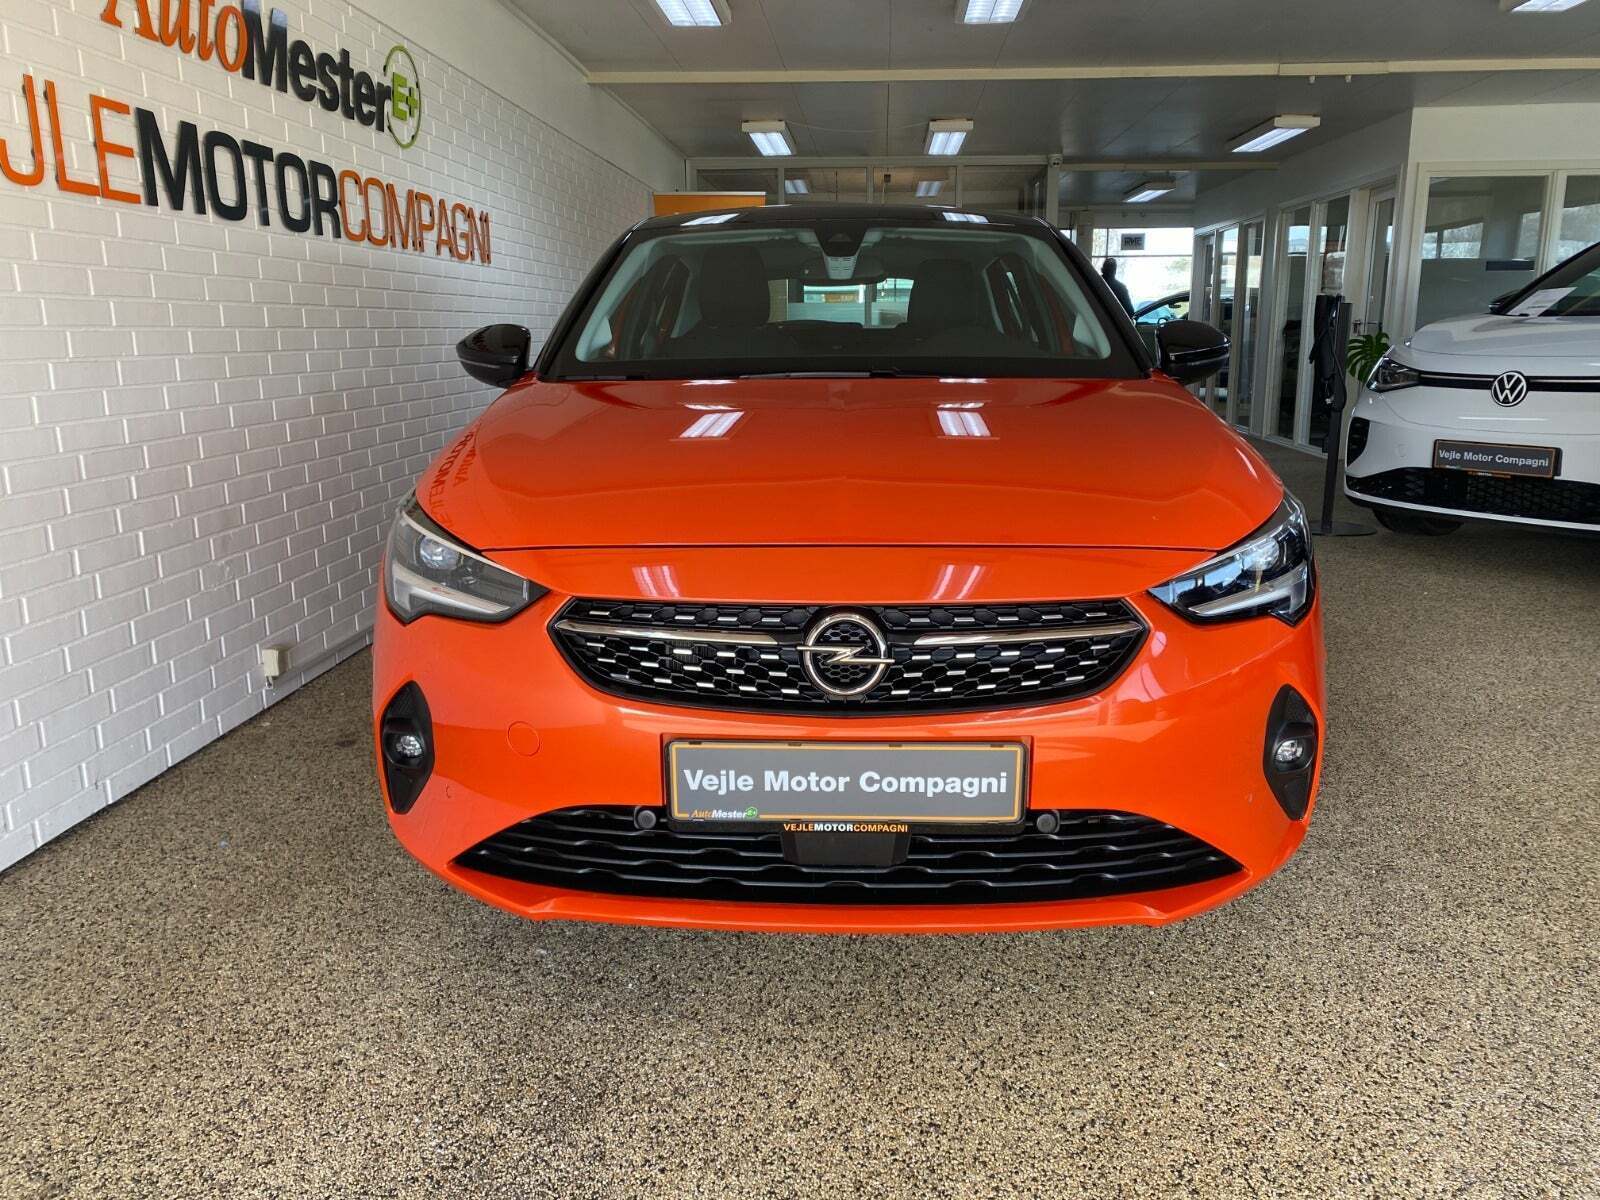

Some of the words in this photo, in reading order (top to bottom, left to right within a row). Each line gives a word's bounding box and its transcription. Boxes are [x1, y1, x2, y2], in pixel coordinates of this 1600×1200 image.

[1439, 449, 1461, 460] Vejle
[1463, 451, 1493, 462] Motor
[1495, 454, 1549, 467] Compagni
[683, 769, 754, 796] Vejle
[764, 770, 850, 793] Motor
[859, 770, 1006, 798] Compagni
[783, 823, 908, 833] VEJLEMOTORCOMPAGNI
